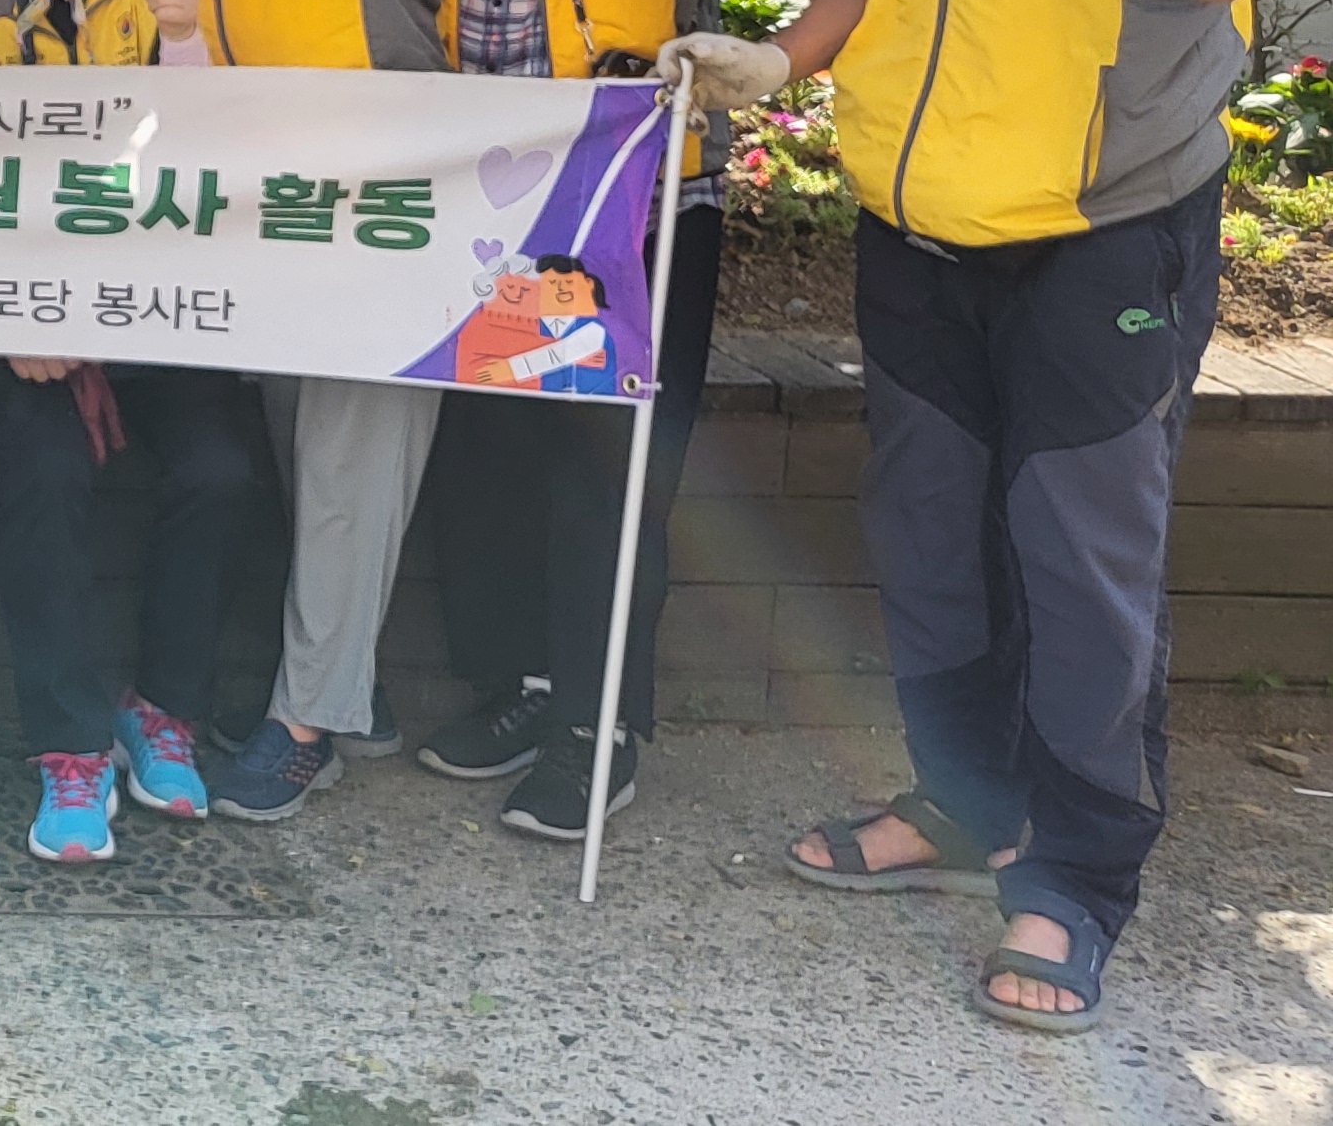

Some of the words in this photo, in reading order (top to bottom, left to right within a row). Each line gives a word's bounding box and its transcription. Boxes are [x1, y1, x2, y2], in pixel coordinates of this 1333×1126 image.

[52, 158, 230, 237] 봉사
[257, 172, 436, 251] 활동
[91, 282, 237, 333] 봉사단
